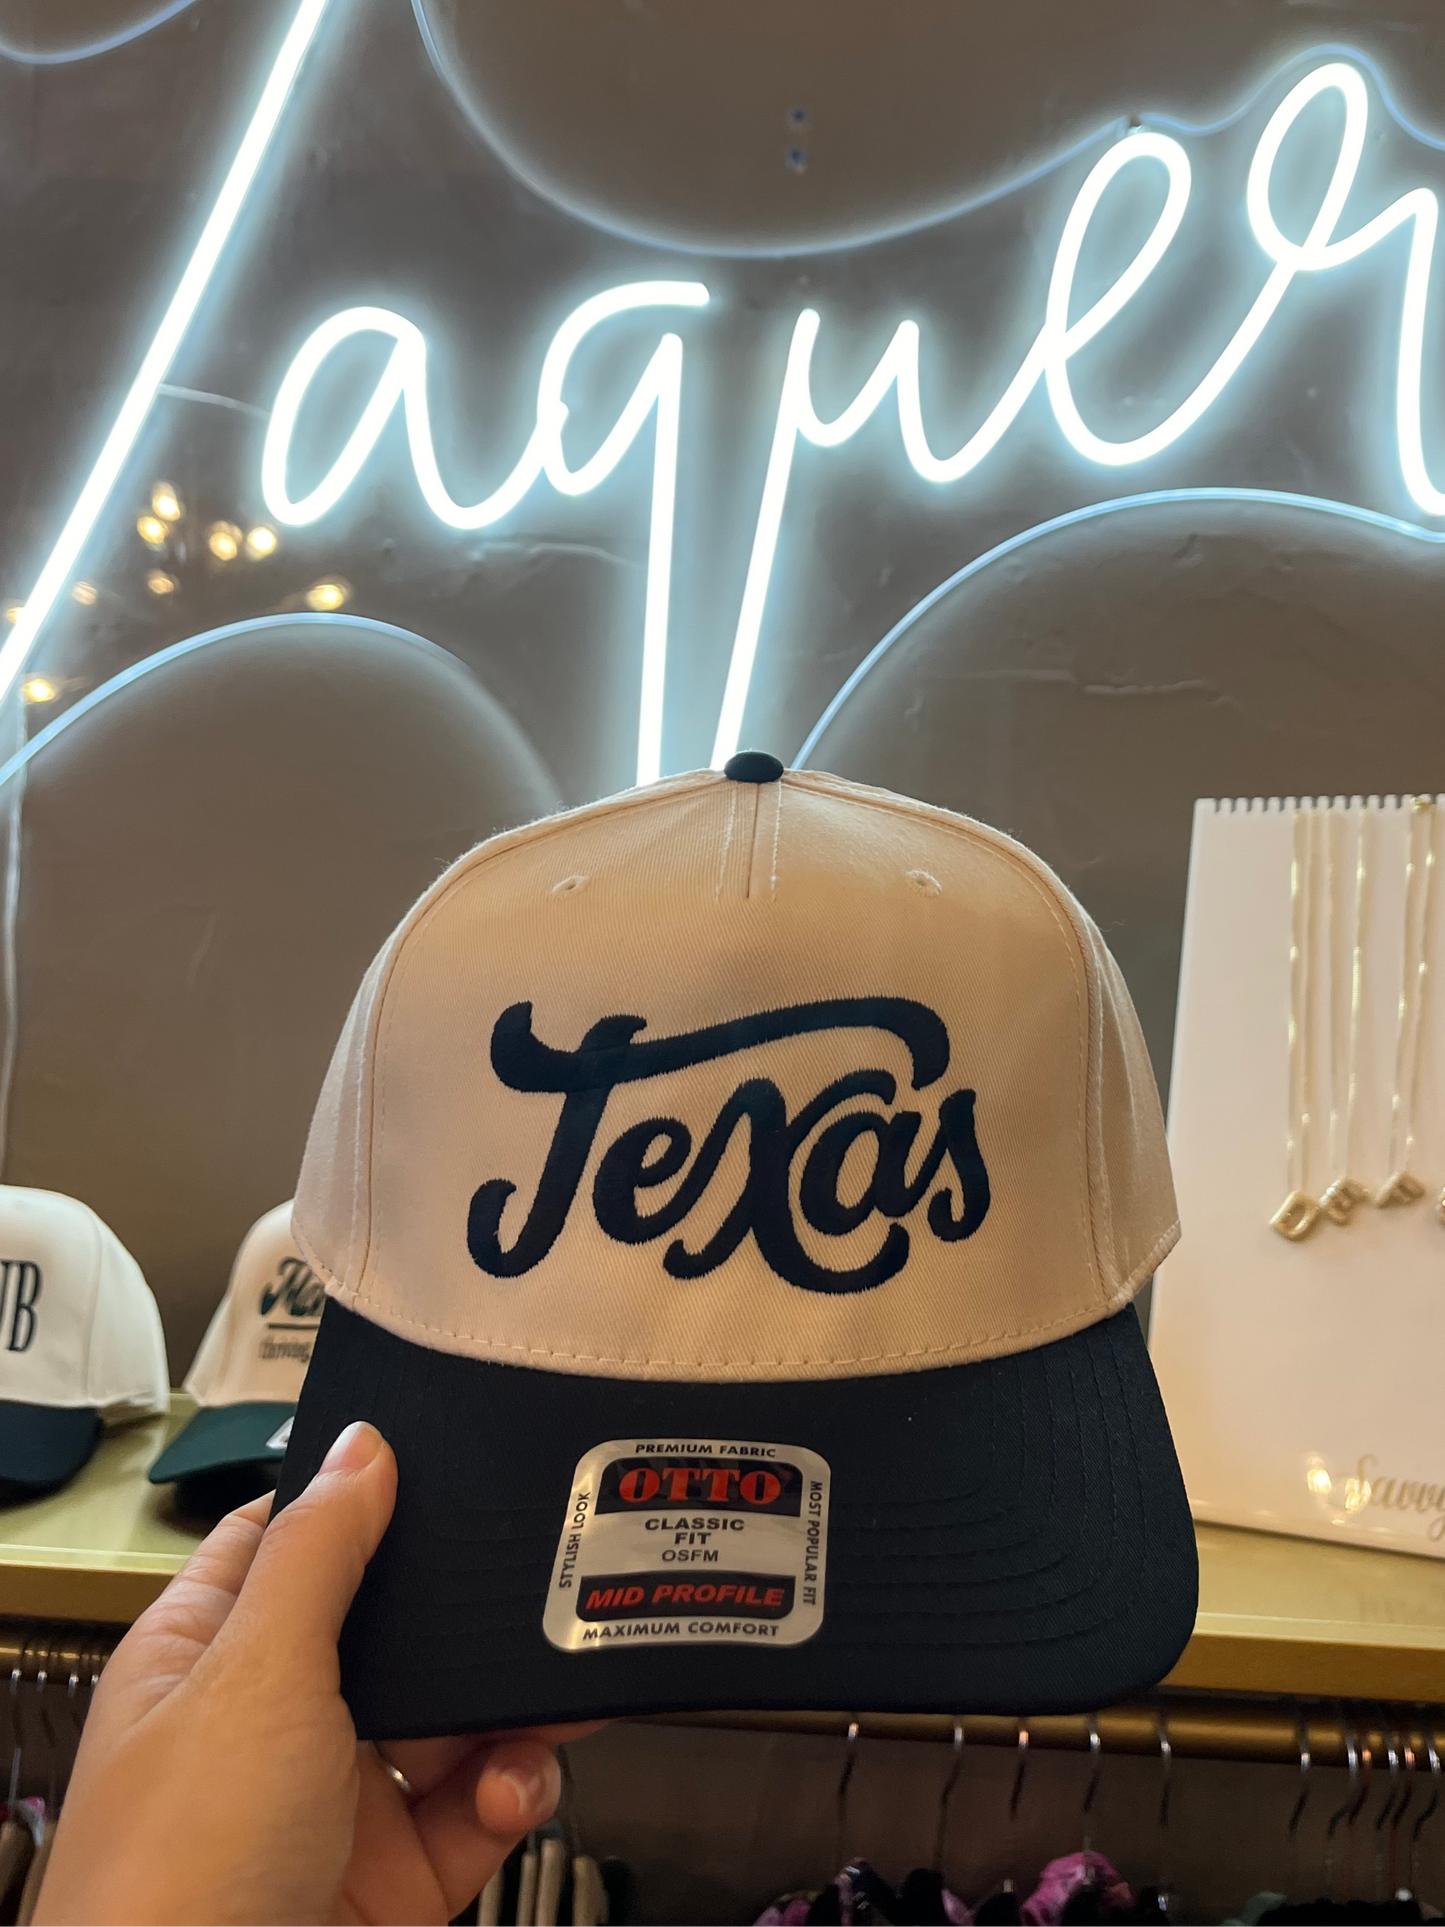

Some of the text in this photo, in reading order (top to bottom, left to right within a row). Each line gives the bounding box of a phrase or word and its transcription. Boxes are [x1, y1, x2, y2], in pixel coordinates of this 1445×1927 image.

[0, 0, 1445, 786] aquer
[467, 996, 991, 1294] Texas
[635, 1443, 777, 1458] PREMIUM FABRIC
[619, 1467, 781, 1505] OTTO
[645, 1517, 745, 1531] CLASSIC
[559, 1491, 591, 1588] STYLISH LOOK
[674, 1532, 712, 1545] FIT
[802, 1480, 823, 1606] MOST POPULAR FIT
[661, 1549, 719, 1562] OSFM
[585, 1583, 785, 1610] MID PROFILE
[583, 1621, 780, 1641] MAXIMUM COMFORT
